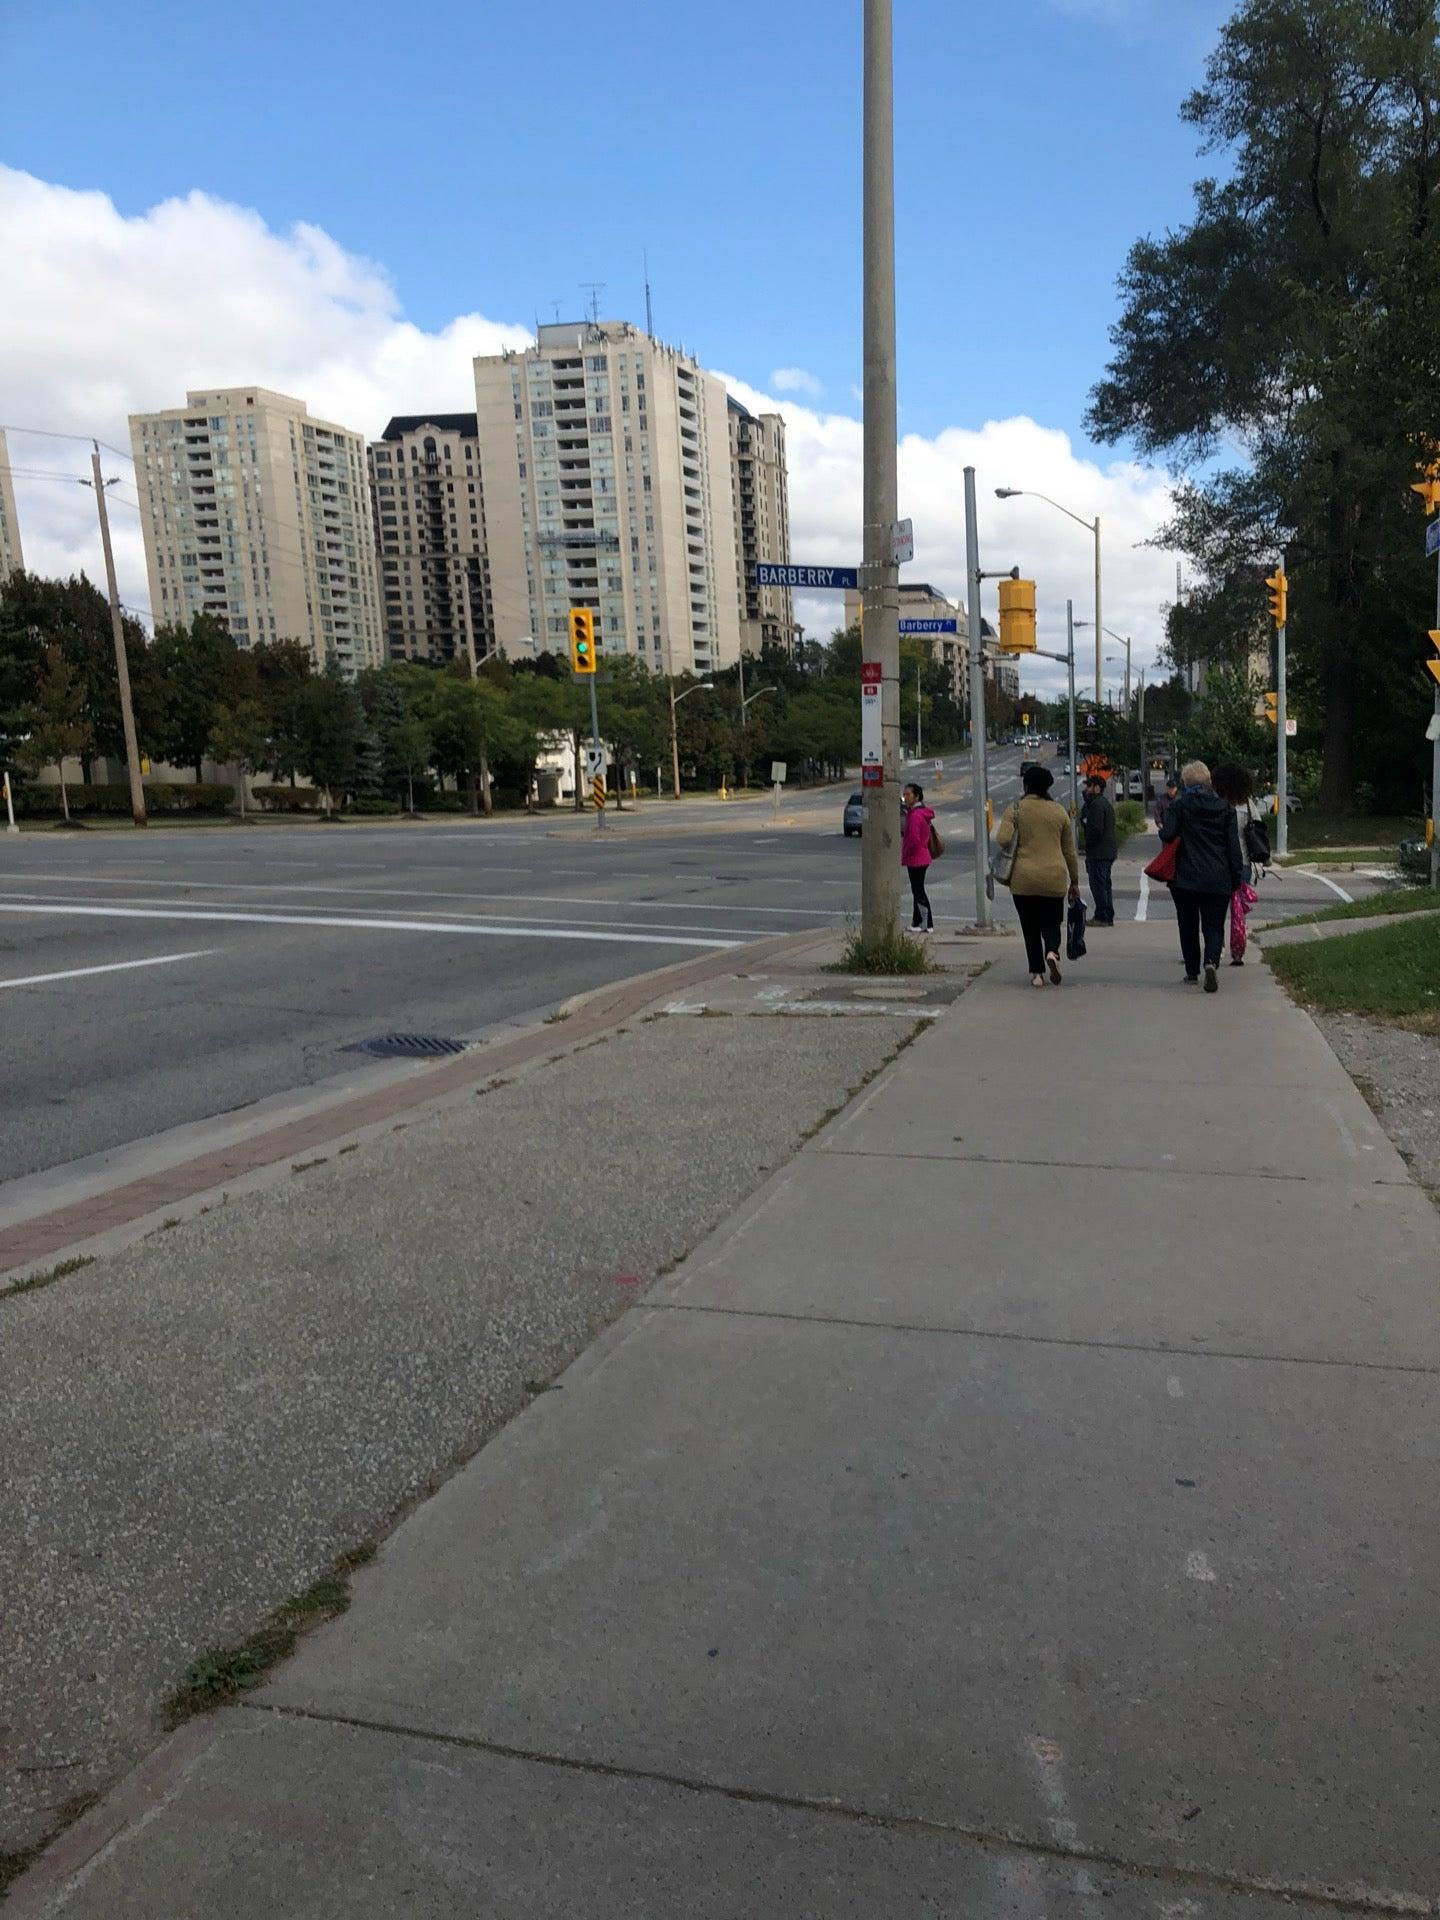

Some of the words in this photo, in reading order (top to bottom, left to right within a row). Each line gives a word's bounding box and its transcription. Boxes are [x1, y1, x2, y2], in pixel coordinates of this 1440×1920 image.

[760, 567, 834, 585] BARBERRY
[841, 576, 851, 585] PL
[900, 620, 943, 633] Barberry
